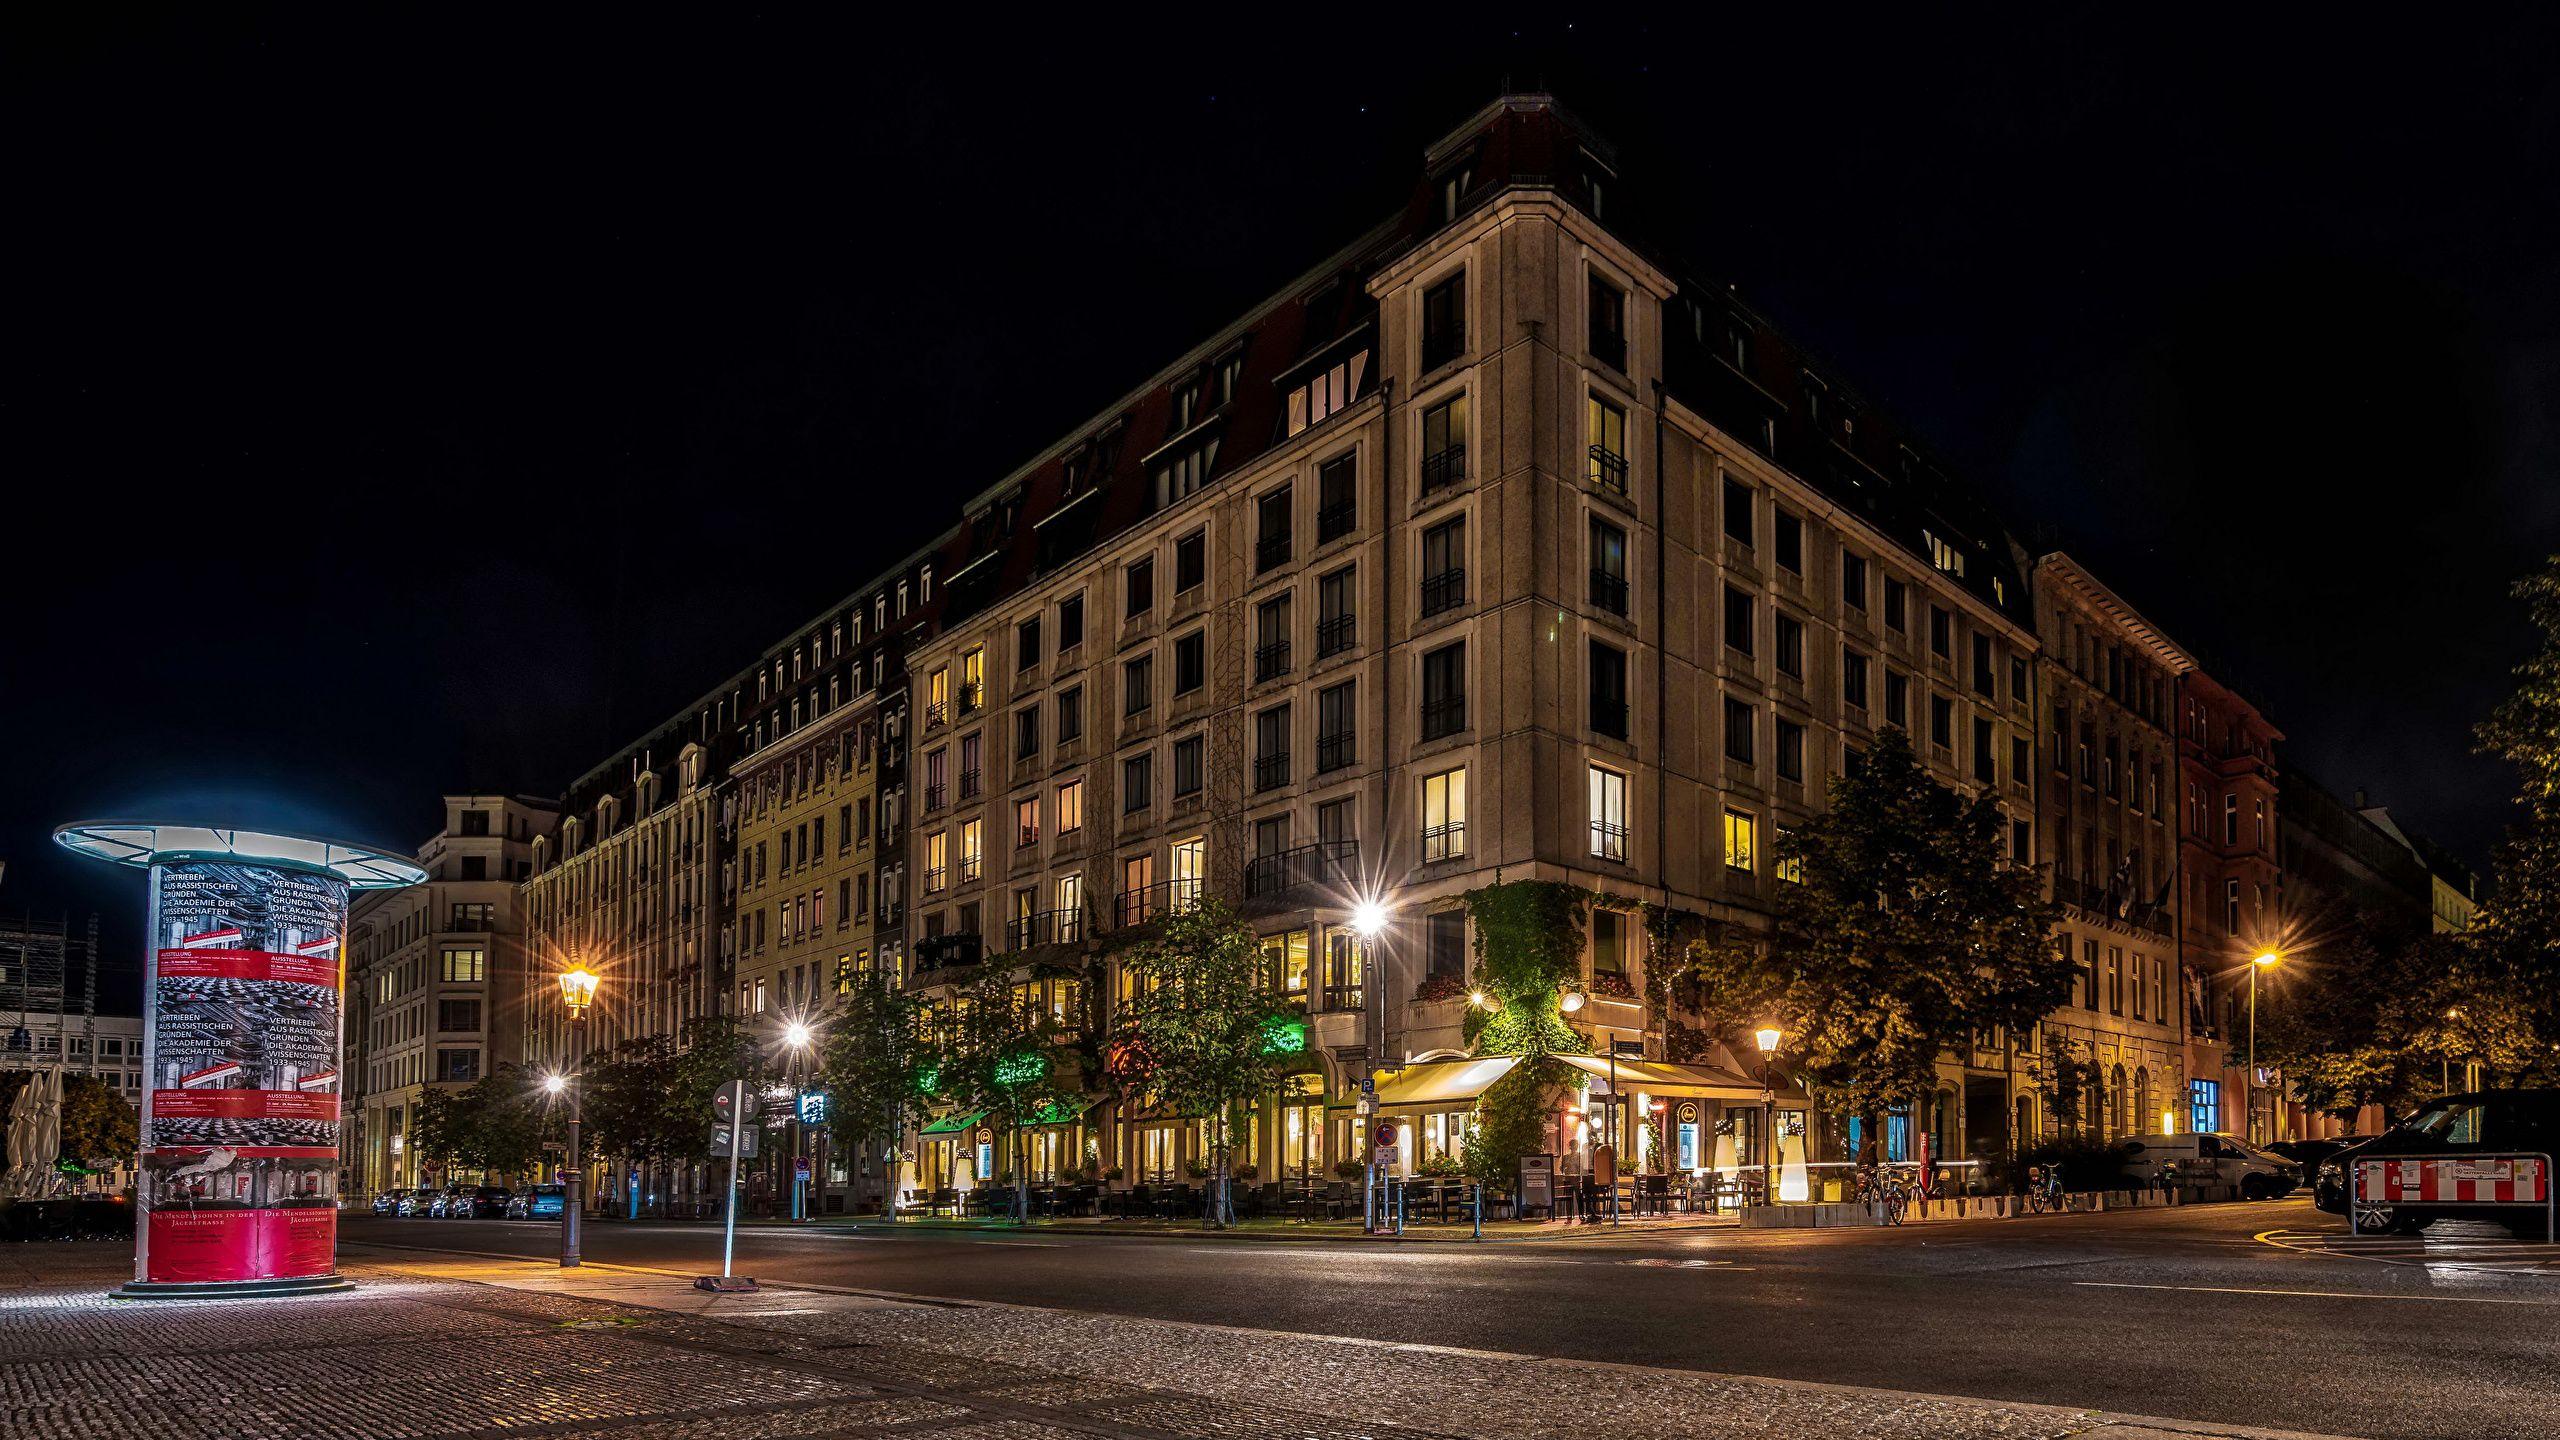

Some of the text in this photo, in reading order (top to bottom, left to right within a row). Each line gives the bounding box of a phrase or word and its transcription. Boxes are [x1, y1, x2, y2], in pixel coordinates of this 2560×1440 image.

[273, 880, 320, 892] VERTRIEBEN
[293, 891, 339, 905] RASSISTISCHEN
[289, 908, 326, 918] AKADEMIE
[272, 914, 334, 928] WISSENSCHAFTEN
[271, 956, 308, 964] AUSSTELLUNG
[270, 1017, 316, 1027] VERTRIEBEN
[289, 1027, 335, 1037] RASSISTISCHEN
[285, 1044, 322, 1052] AKADEMIE
[269, 1050, 330, 1060] WISSENSCHAFTEN
[1364, 1081, 1370, 1091] P
